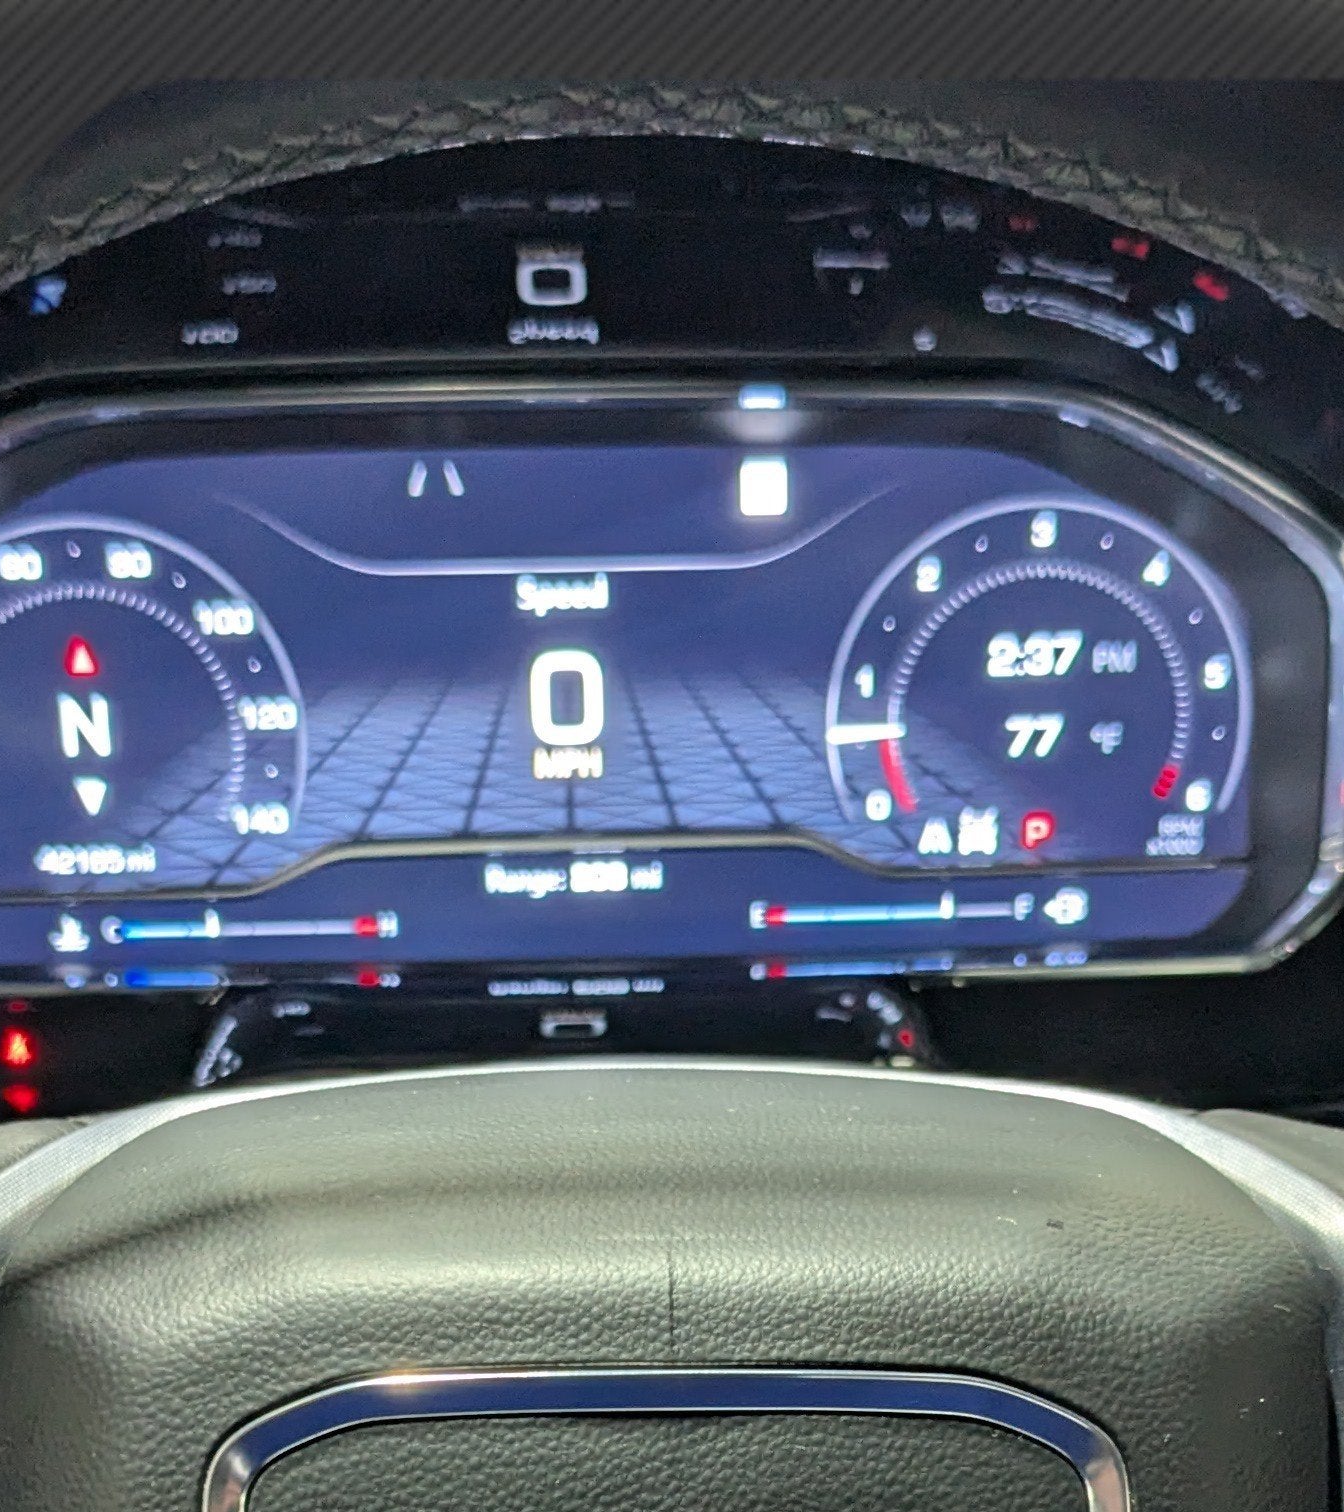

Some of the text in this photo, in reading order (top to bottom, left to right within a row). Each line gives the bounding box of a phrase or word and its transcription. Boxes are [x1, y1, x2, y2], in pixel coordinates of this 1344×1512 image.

[1031, 510, 1057, 548] 3
[916, 554, 942, 591] 2
[1142, 550, 1172, 586] 4
[516, 572, 609, 616] Speed
[194, 600, 254, 636] 100
[987, 630, 1137, 678] 2:37 PM
[1203, 652, 1231, 690] 5
[529, 650, 604, 746] 0
[855, 664, 874, 698] 1
[58, 693, 112, 758] N
[239, 694, 298, 731] 120
[1005, 714, 1066, 758] 77
[532, 747, 603, 779] MPH
[230, 804, 290, 836] 140
[866, 790, 892, 822] 0
[1022, 810, 1055, 850] P
[485, 862, 567, 899] Range:
